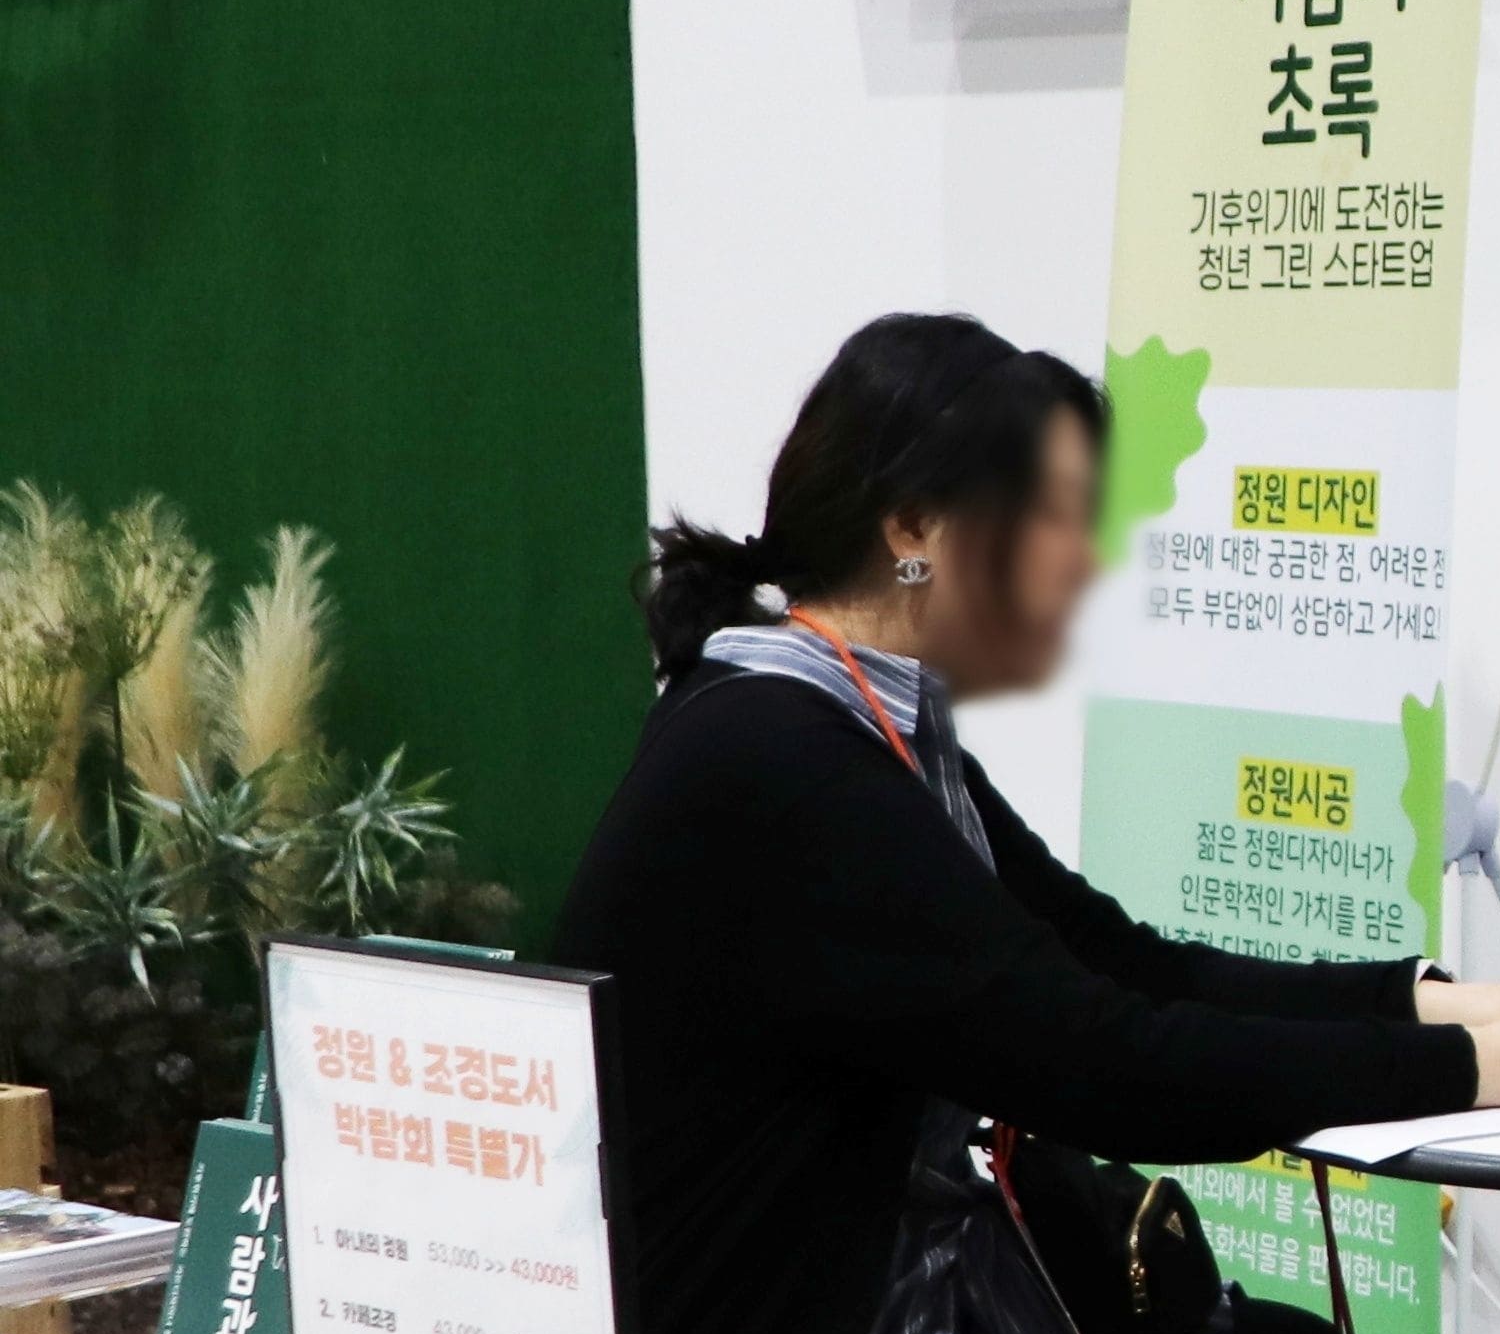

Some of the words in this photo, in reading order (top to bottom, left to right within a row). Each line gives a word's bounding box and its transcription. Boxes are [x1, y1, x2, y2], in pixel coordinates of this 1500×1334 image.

[1261, 40, 1380, 159] 초록
[1189, 185, 1327, 238] 기후위기에
[1334, 181, 1445, 233] 도전하는
[1198, 243, 1252, 293] 청년
[1259, 242, 1314, 290] 그린
[1322, 238, 1435, 290] 스타트업
[1237, 471, 1287, 524] 정원
[1297, 474, 1377, 529] 디자인
[1221, 536, 1261, 576] 대한
[1267, 538, 1329, 581] 궁금한
[1370, 545, 1429, 588] 어려운
[1150, 587, 1194, 627] 모두
[1203, 589, 1284, 632] 부담없이
[1291, 595, 1375, 637] 상담하고
[1243, 763, 1351, 826] 정원시공
[1197, 822, 1237, 864] 젊은
[1244, 827, 1394, 883] 정원디자이너가
[1180, 873, 1285, 927] 인문학적인
[1292, 890, 1356, 937] 가치를
[1364, 900, 1405, 944] 담은
[312, 1024, 377, 1083] 정원
[389, 1036, 413, 1087] &
[422, 1041, 559, 1112] 조경도서
[335, 1102, 435, 1167] 박람회
[445, 1119, 547, 1187] 특별가
[1172, 1164, 1268, 1215] 내외에서
[1274, 1181, 1295, 1224] 볼
